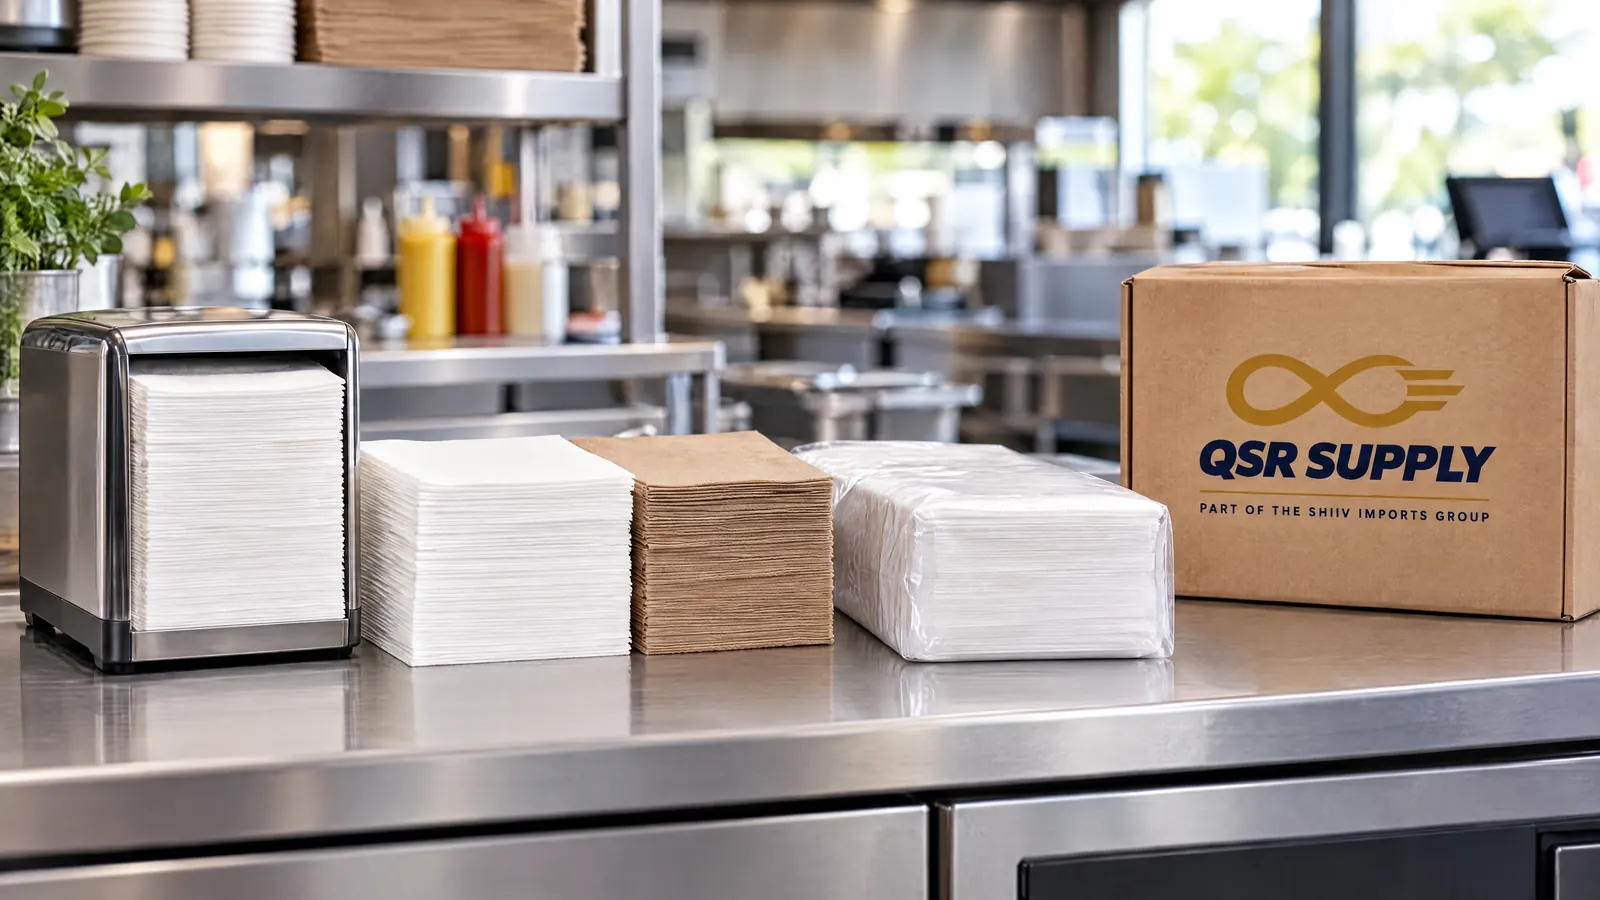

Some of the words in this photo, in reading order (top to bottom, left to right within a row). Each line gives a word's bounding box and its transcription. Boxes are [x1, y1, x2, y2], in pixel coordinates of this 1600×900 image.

[1199, 439, 1298, 480] QSR
[1305, 442, 1497, 483] SUPPLY
[1199, 503, 1238, 515] PART
[1245, 504, 1264, 515] OF
[1271, 505, 1301, 517] THE
[1308, 506, 1350, 518] SHIIV
[1358, 508, 1428, 521] IMPORTS
[1435, 511, 1490, 523] GROUP
